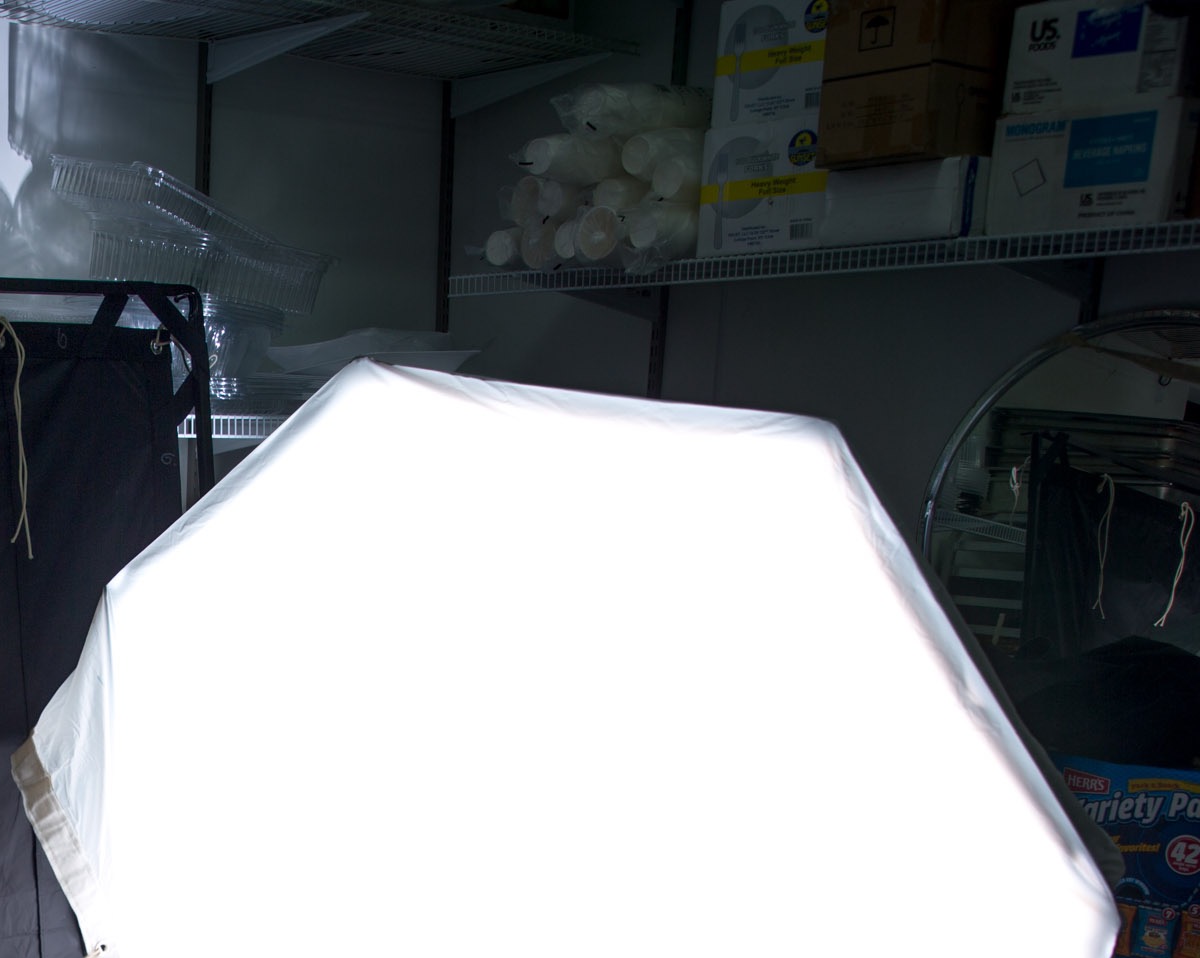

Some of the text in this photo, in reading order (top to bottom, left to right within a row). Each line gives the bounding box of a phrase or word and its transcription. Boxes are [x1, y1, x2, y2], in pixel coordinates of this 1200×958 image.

[1006, 120, 1067, 137] MONOGRAM
[751, 177, 797, 190] Heavy Weight
[758, 186, 786, 196] Full Size
[1067, 774, 1106, 791] HERR'S
[1080, 791, 1164, 824] ariety
[1170, 841, 1200, 865] 42
